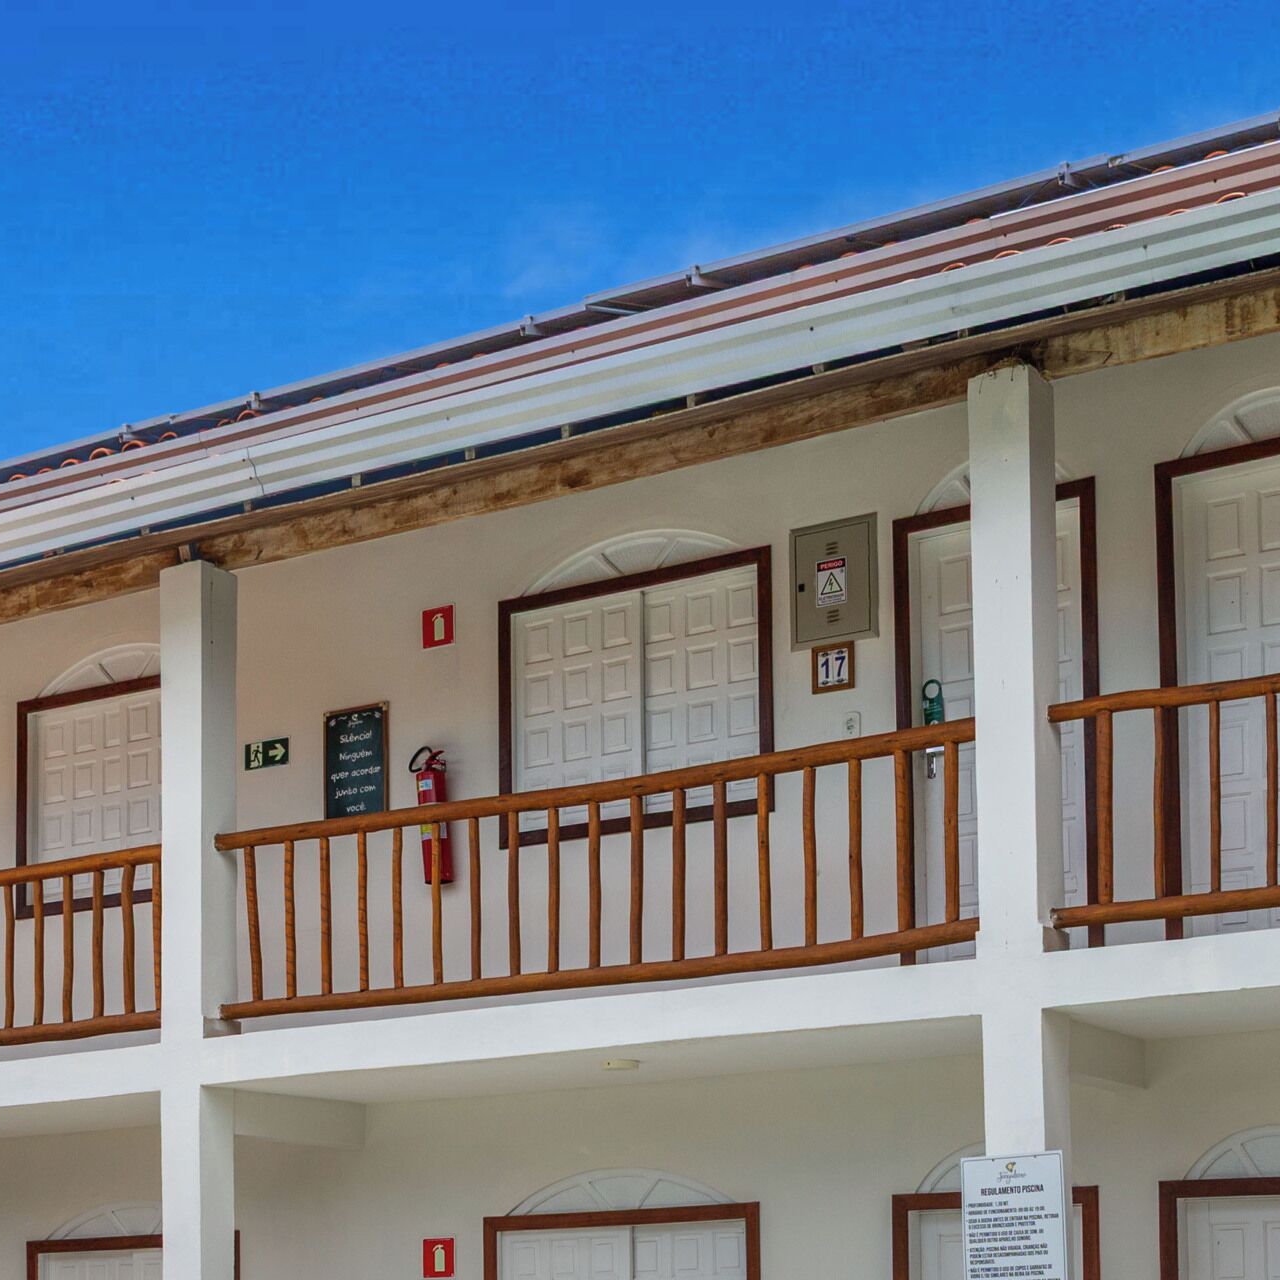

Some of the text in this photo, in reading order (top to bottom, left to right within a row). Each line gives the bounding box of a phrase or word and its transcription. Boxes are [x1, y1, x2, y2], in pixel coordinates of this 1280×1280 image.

[820, 560, 843, 570] PERIGO
[821, 655, 846, 679] 17
[339, 751, 372, 762] Ninguém
[331, 765, 381, 783] quer acordar
[335, 785, 376, 799] junto com
[981, 1184, 1044, 1196] REGULAMENTO PISCINA
